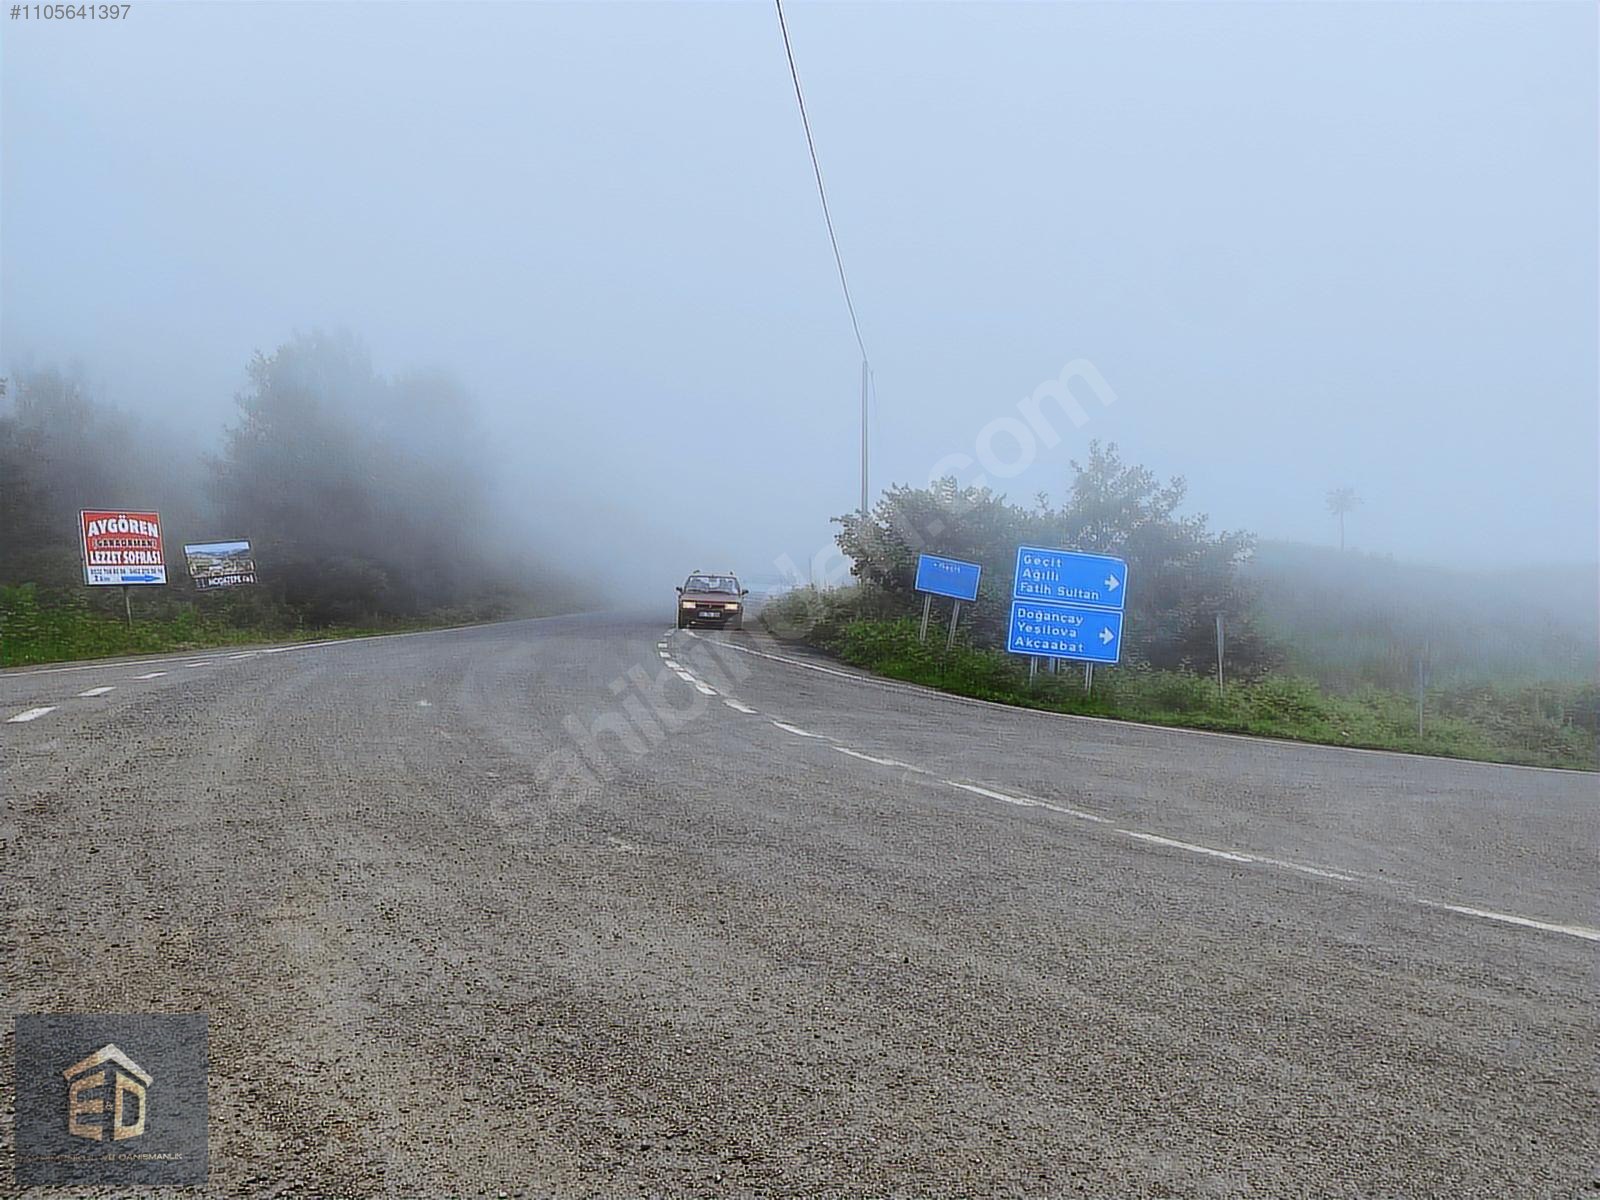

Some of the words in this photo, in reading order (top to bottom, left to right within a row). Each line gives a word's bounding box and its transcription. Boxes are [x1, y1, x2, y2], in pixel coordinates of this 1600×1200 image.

[88, 514, 158, 538] AYGÖREN
[90, 550, 122, 564] LEZZET
[1023, 554, 1062, 568] Geçit
[1020, 581, 1051, 595] Fatih
[1057, 585, 1099, 600] Sultan
[1017, 621, 1077, 638] Yeşilova
[1014, 635, 1084, 653] Akçaabat
